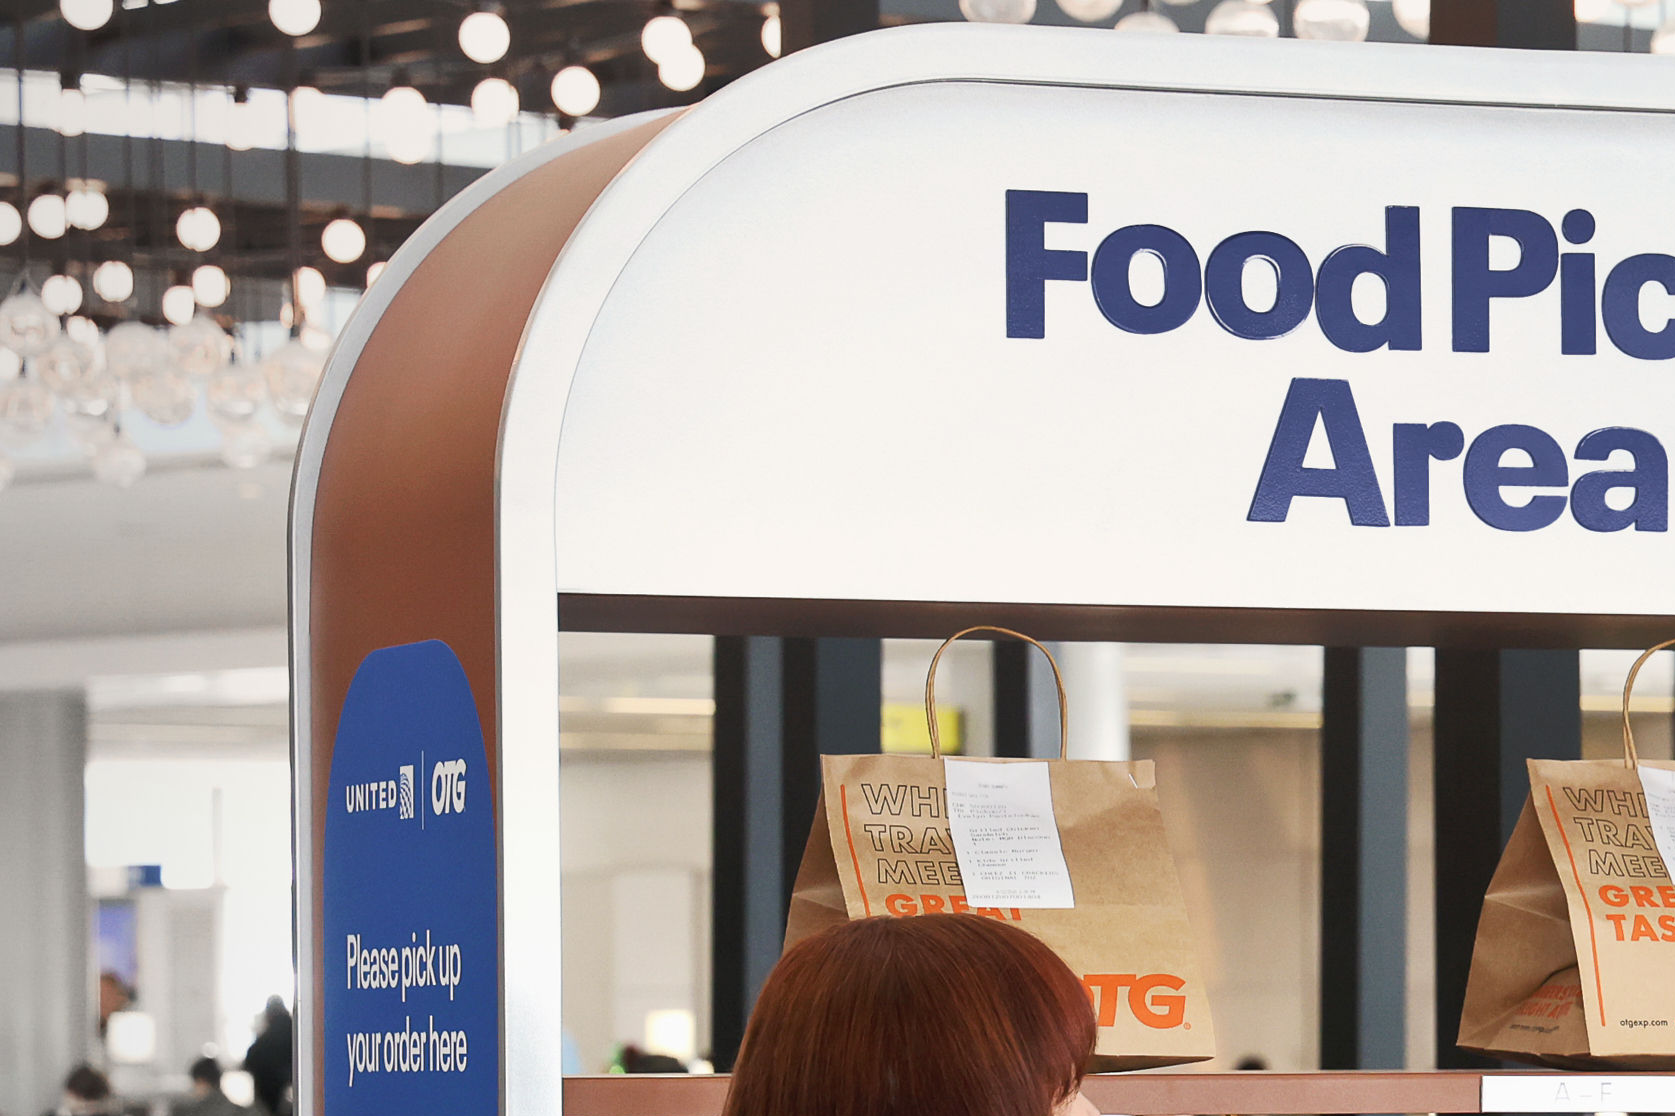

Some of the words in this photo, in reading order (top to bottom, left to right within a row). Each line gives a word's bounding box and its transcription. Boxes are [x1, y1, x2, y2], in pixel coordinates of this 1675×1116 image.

[1004, 189, 1422, 353] Food
[1246, 376, 1670, 533] Area
[346, 780, 397, 813] UNITED
[431, 758, 466, 815] OTG
[347, 934, 399, 989] Please
[402, 929, 436, 1002] pick
[439, 944, 461, 1001] up
[1081, 973, 1186, 1029] TG
[347, 1031, 382, 1087] your
[384, 1015, 426, 1072] order
[429, 1015, 467, 1072] here
[1620, 1018, 1668, 1028] otgexp.com
